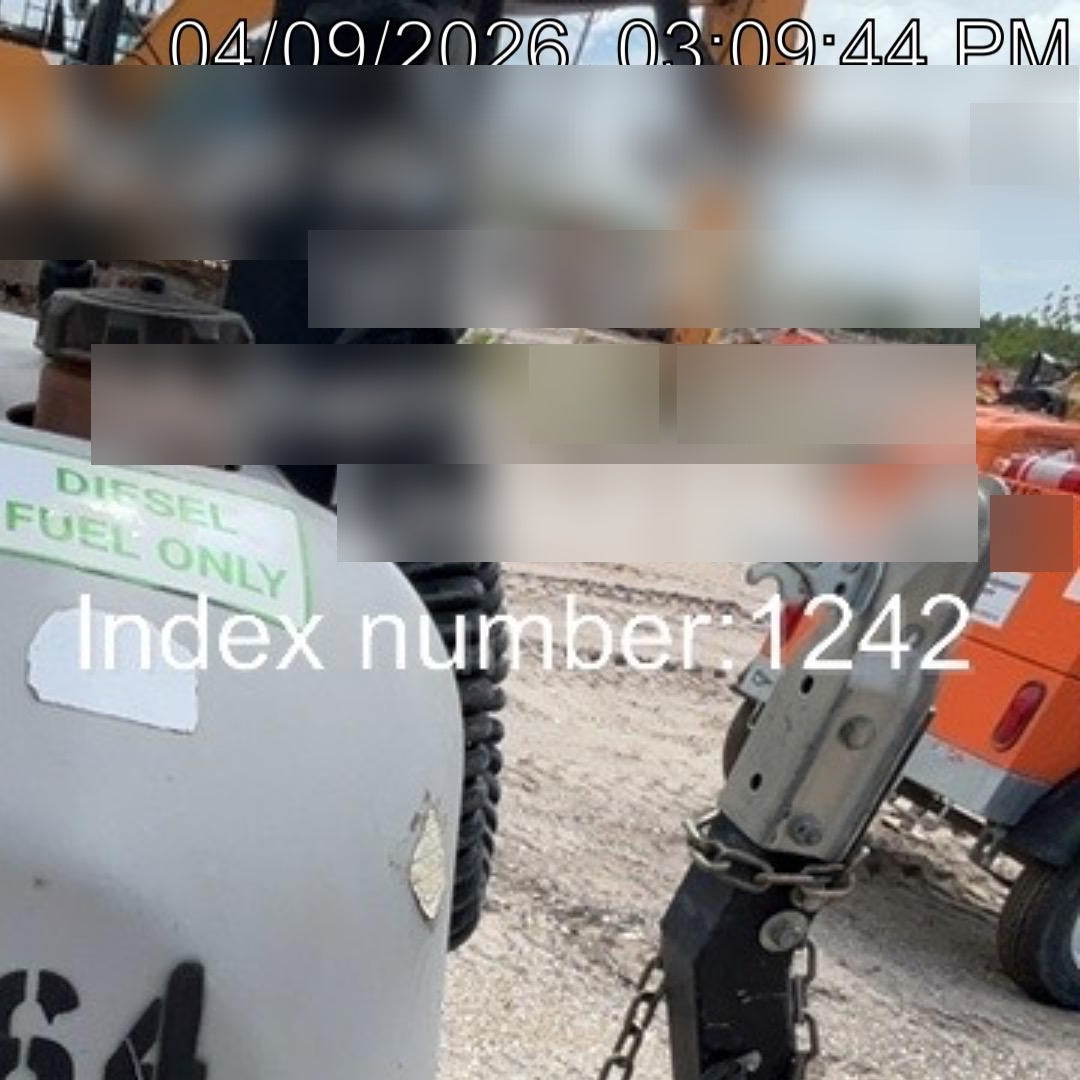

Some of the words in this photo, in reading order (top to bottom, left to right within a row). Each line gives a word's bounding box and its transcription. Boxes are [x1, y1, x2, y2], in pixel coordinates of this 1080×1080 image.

[57, 467, 238, 534] DIESEL
[6, 501, 142, 559] FUEL
[158, 538, 288, 598] ONLY
